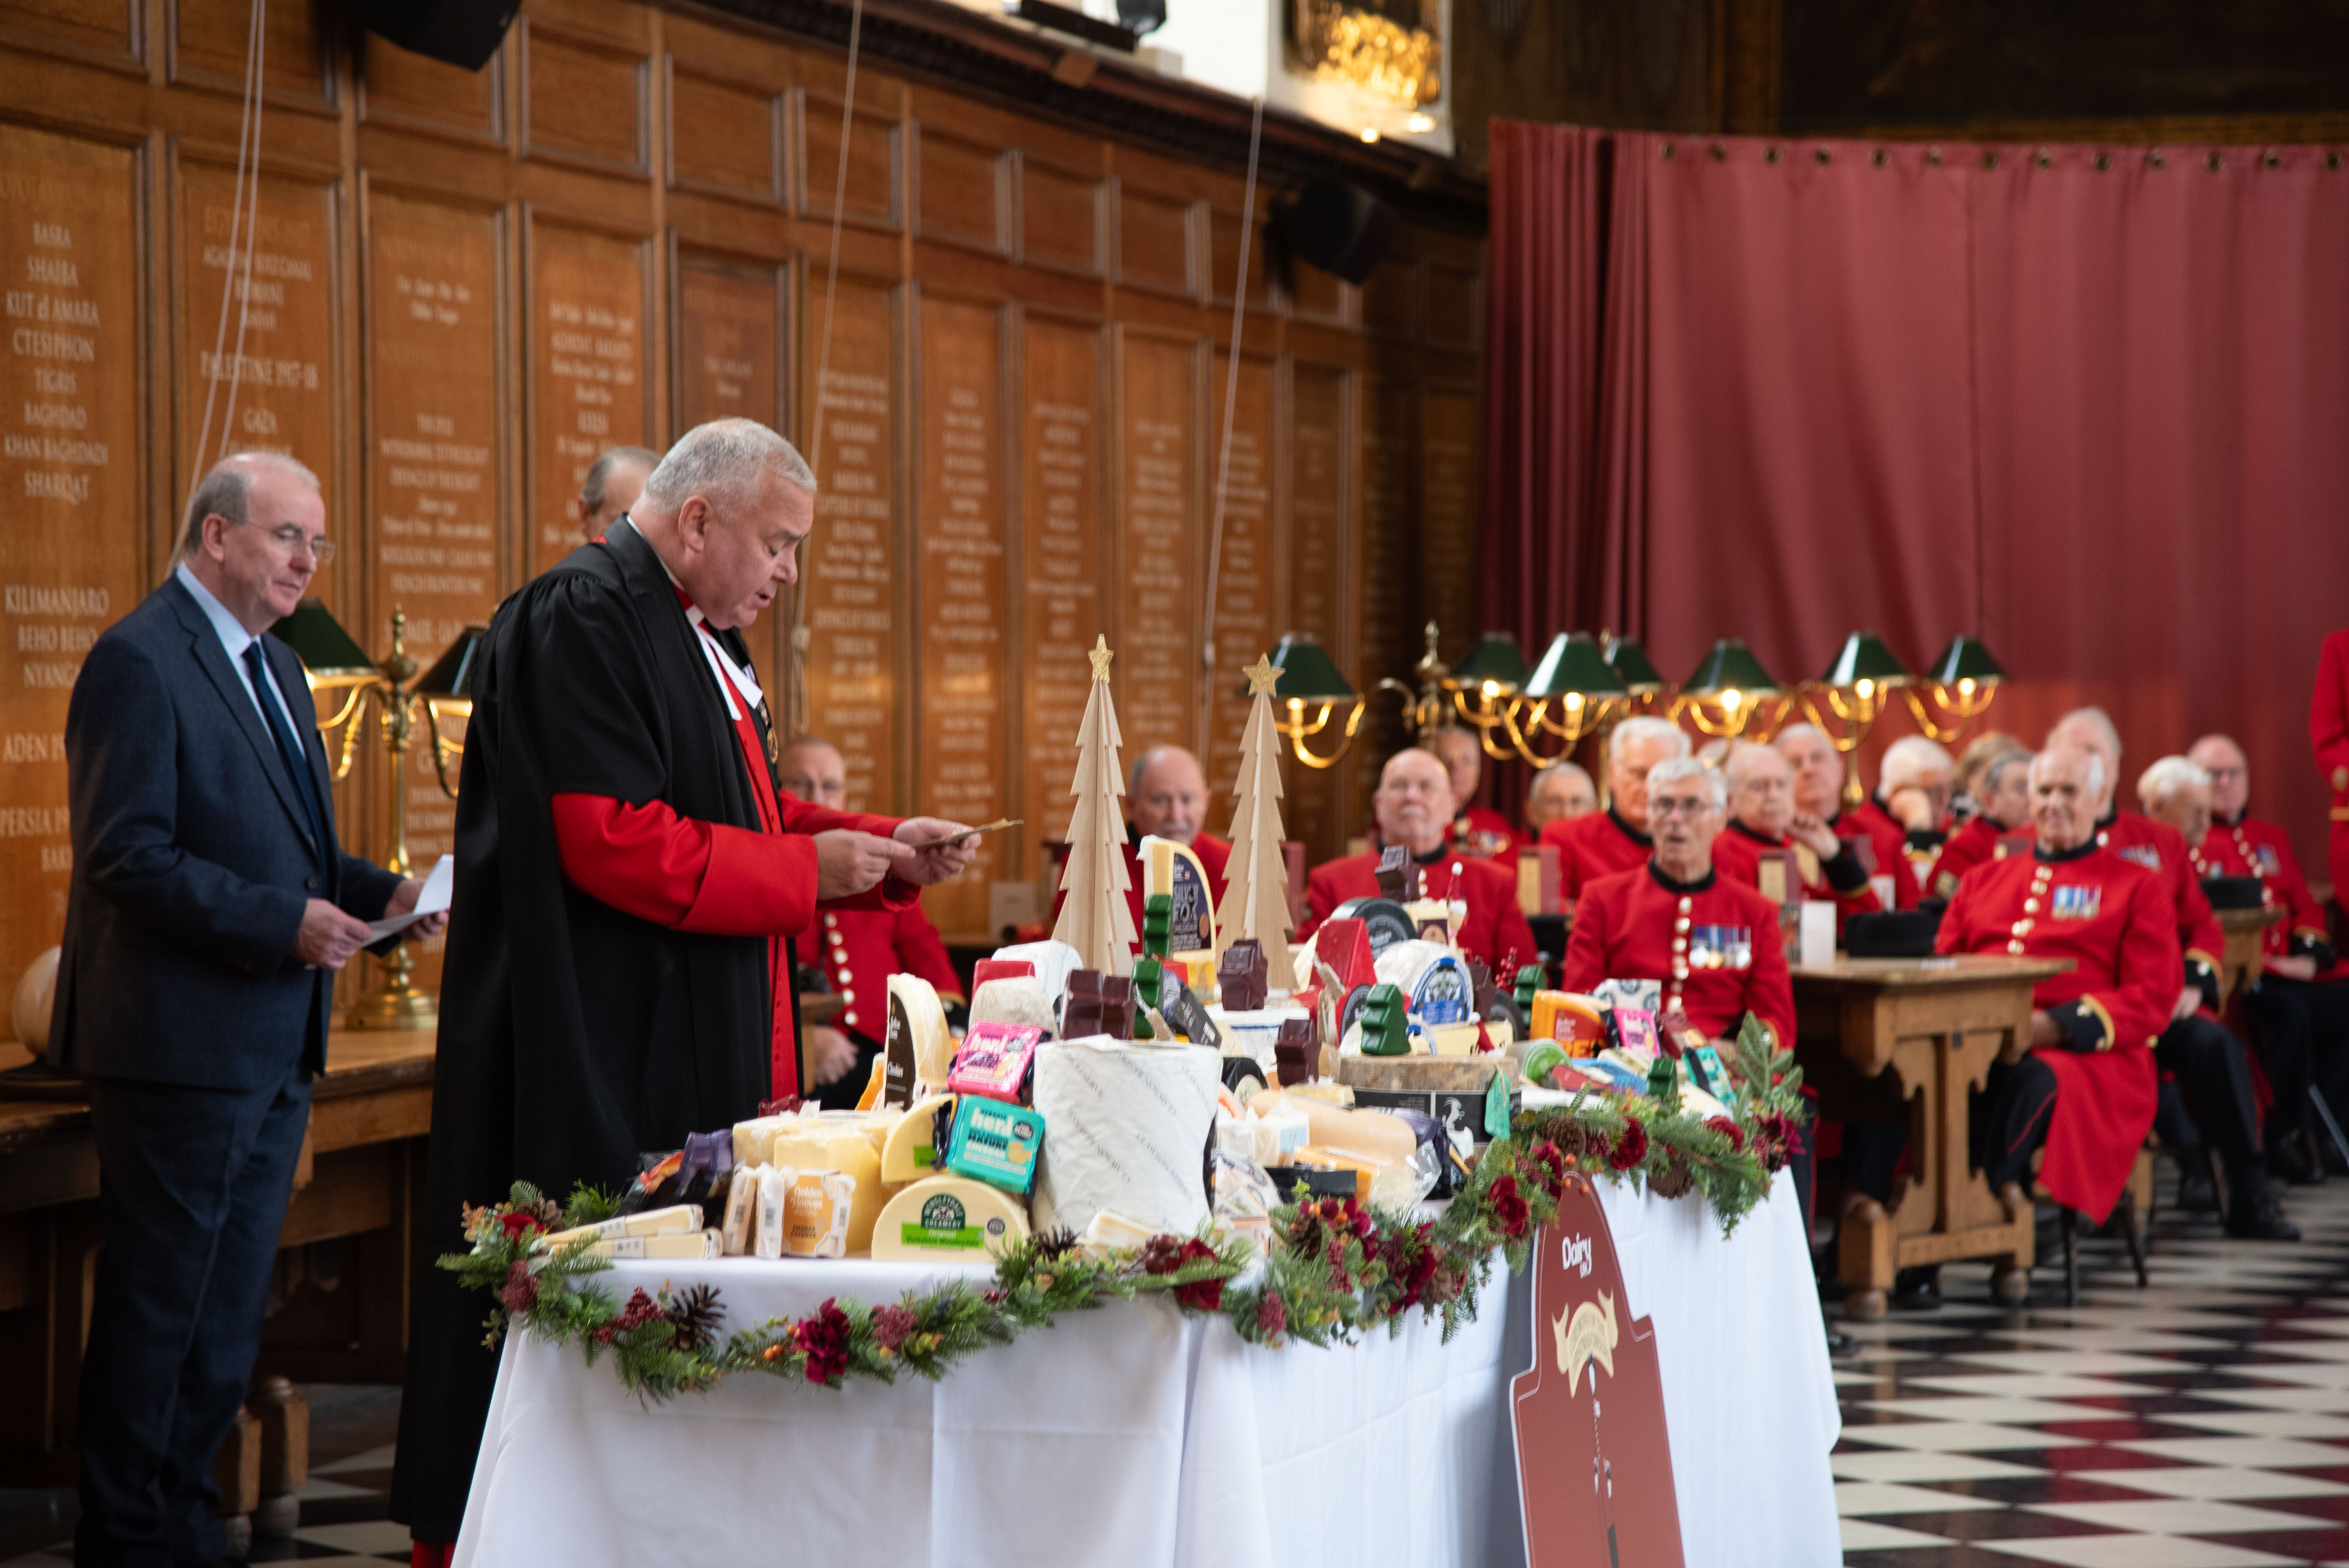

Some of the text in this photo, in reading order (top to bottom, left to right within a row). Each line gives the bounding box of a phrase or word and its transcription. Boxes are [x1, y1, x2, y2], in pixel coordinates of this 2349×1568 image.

[5, 584, 110, 621] KILIMANJARO
[3, 732, 48, 764] ADEN
[970, 1106, 1014, 1137] herd
[794, 1185, 823, 1198] Golden
[924, 1195, 963, 1218] WENSLEYDALE
[925, 1219, 961, 1229] CREAMERY
[1562, 1231, 1593, 1275] Dairy
